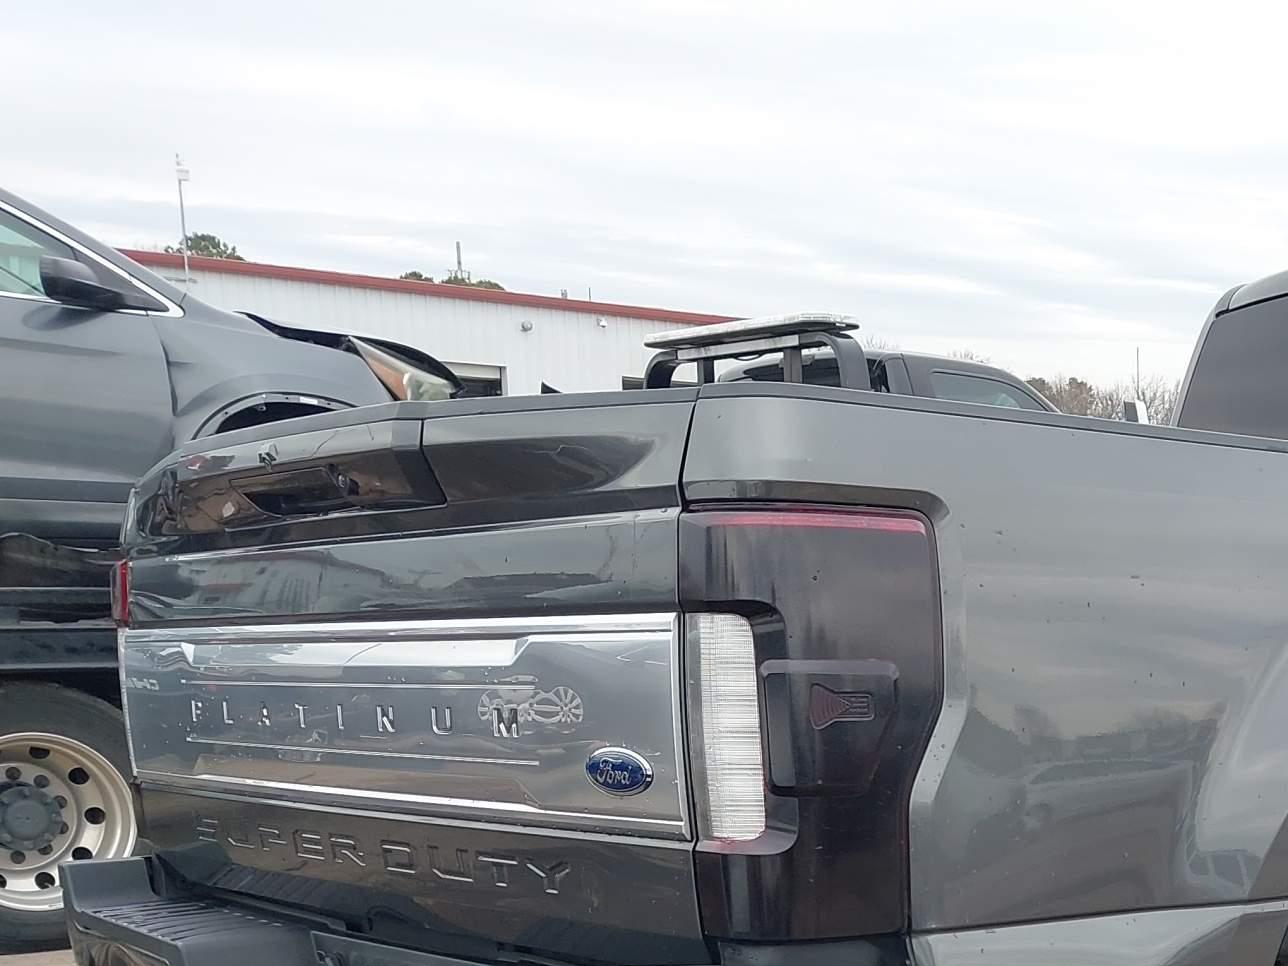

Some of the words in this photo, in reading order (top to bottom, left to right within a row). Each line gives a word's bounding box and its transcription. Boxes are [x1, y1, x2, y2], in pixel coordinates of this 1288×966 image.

[191, 699, 520, 738] PLATINUM
[596, 757, 632, 785] Ford
[196, 815, 367, 867] SUPER
[380, 840, 571, 895] DUTY
